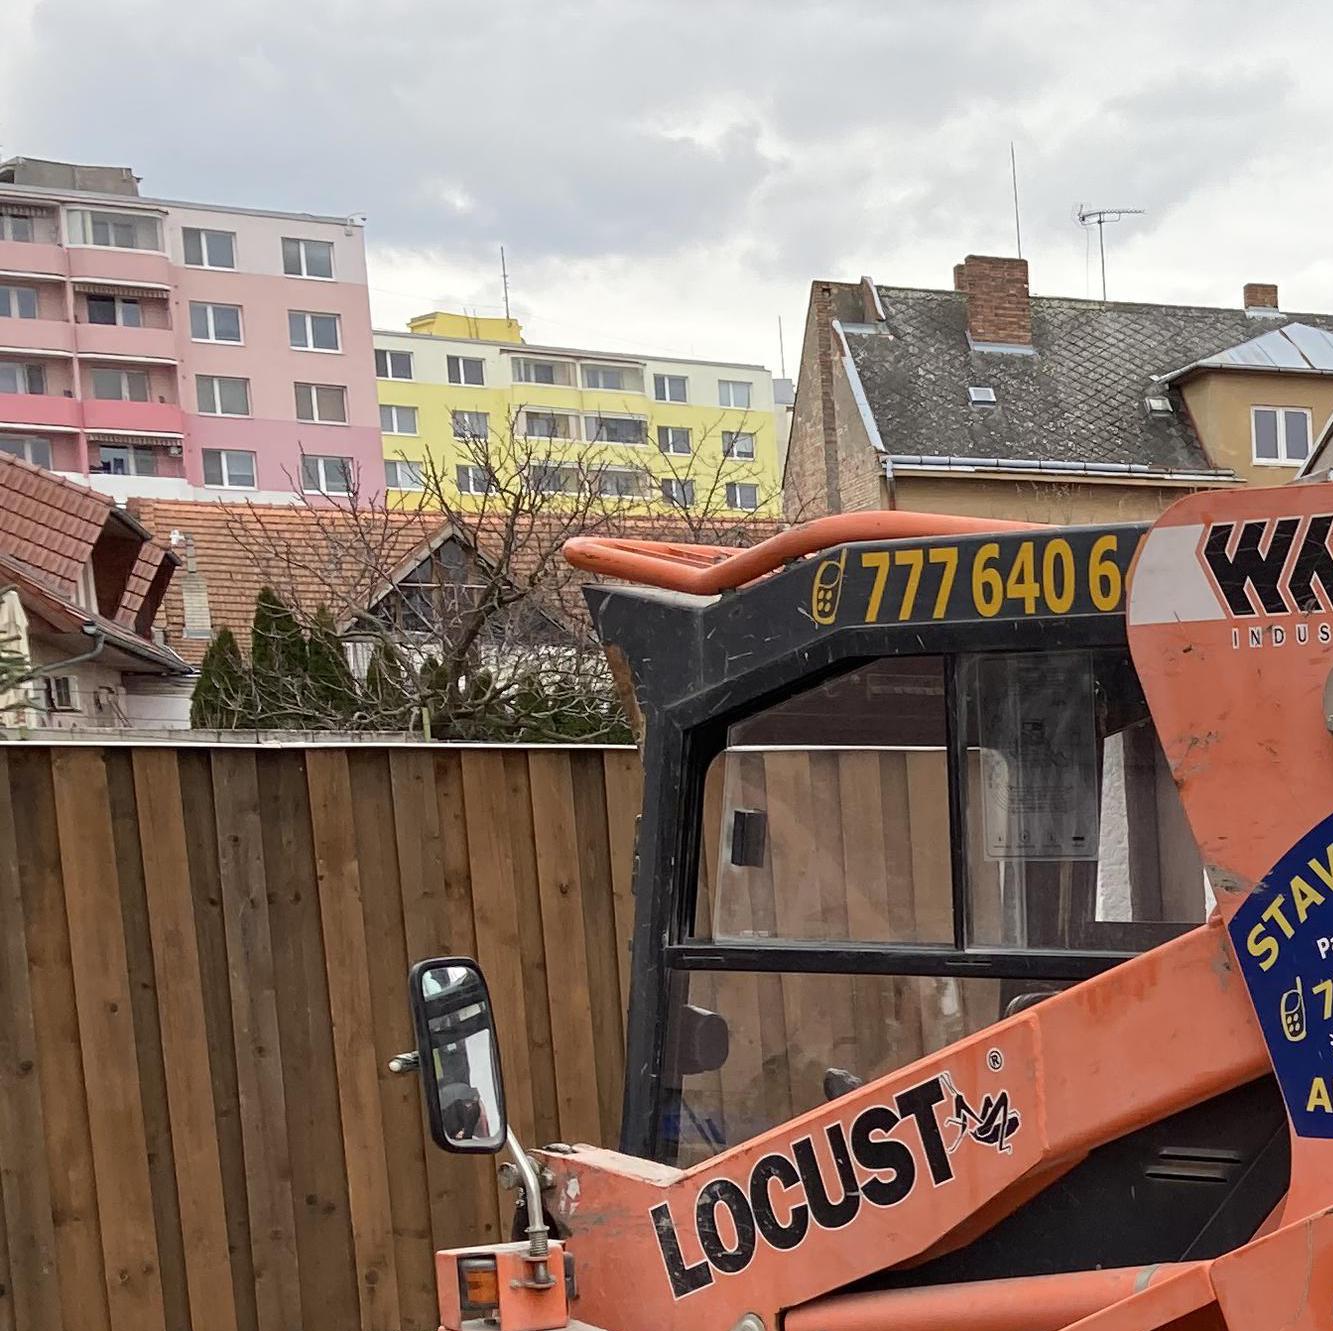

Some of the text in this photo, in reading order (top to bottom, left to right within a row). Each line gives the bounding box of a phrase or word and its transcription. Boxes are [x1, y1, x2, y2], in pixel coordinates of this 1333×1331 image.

[861, 547, 959, 622] 777
[972, 538, 1076, 618] 640
[649, 1074, 954, 1300] LOCUST
